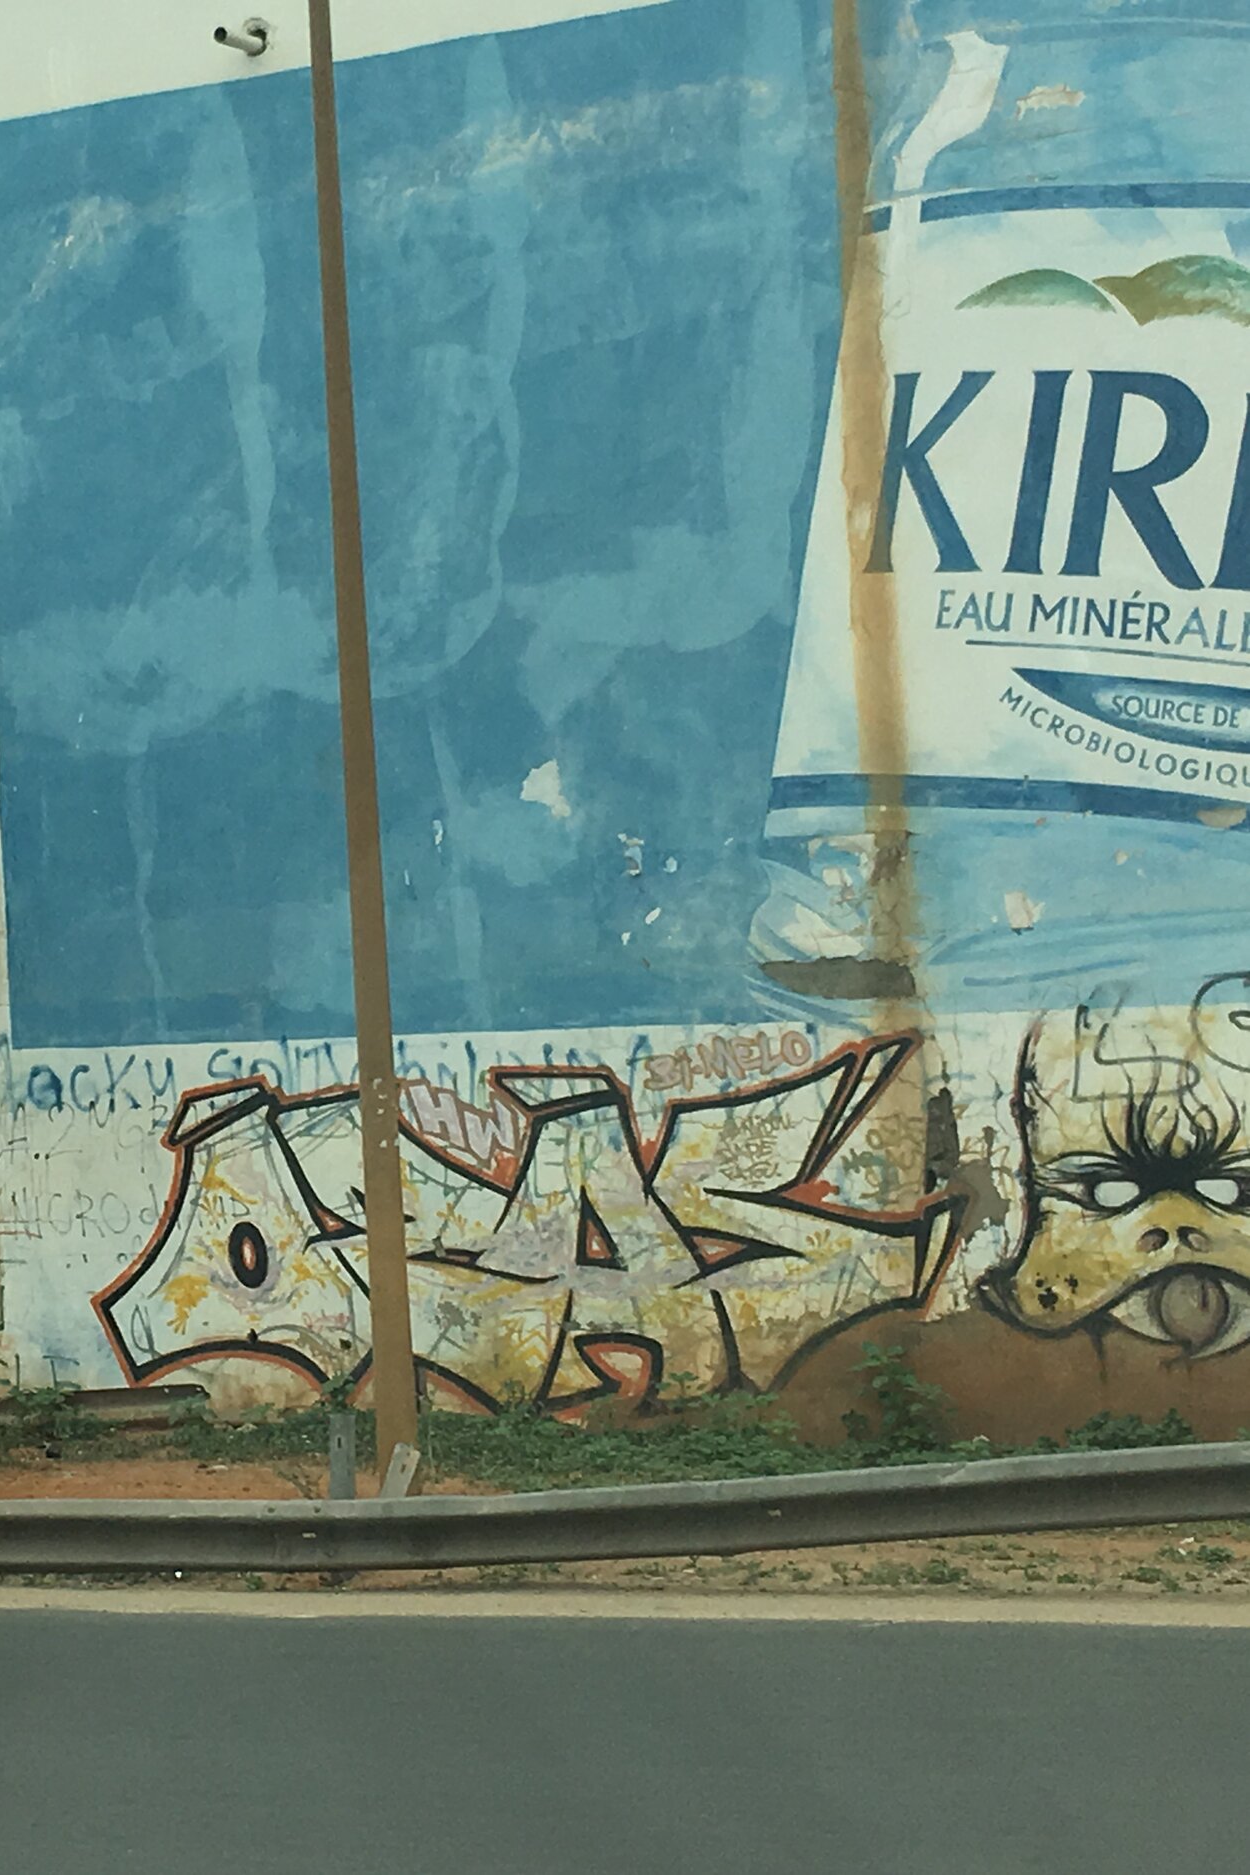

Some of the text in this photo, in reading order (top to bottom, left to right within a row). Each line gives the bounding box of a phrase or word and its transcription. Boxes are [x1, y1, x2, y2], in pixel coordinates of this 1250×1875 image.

[936, 588, 1015, 632] EAU
[1111, 695, 1240, 729] SOURCE DE
